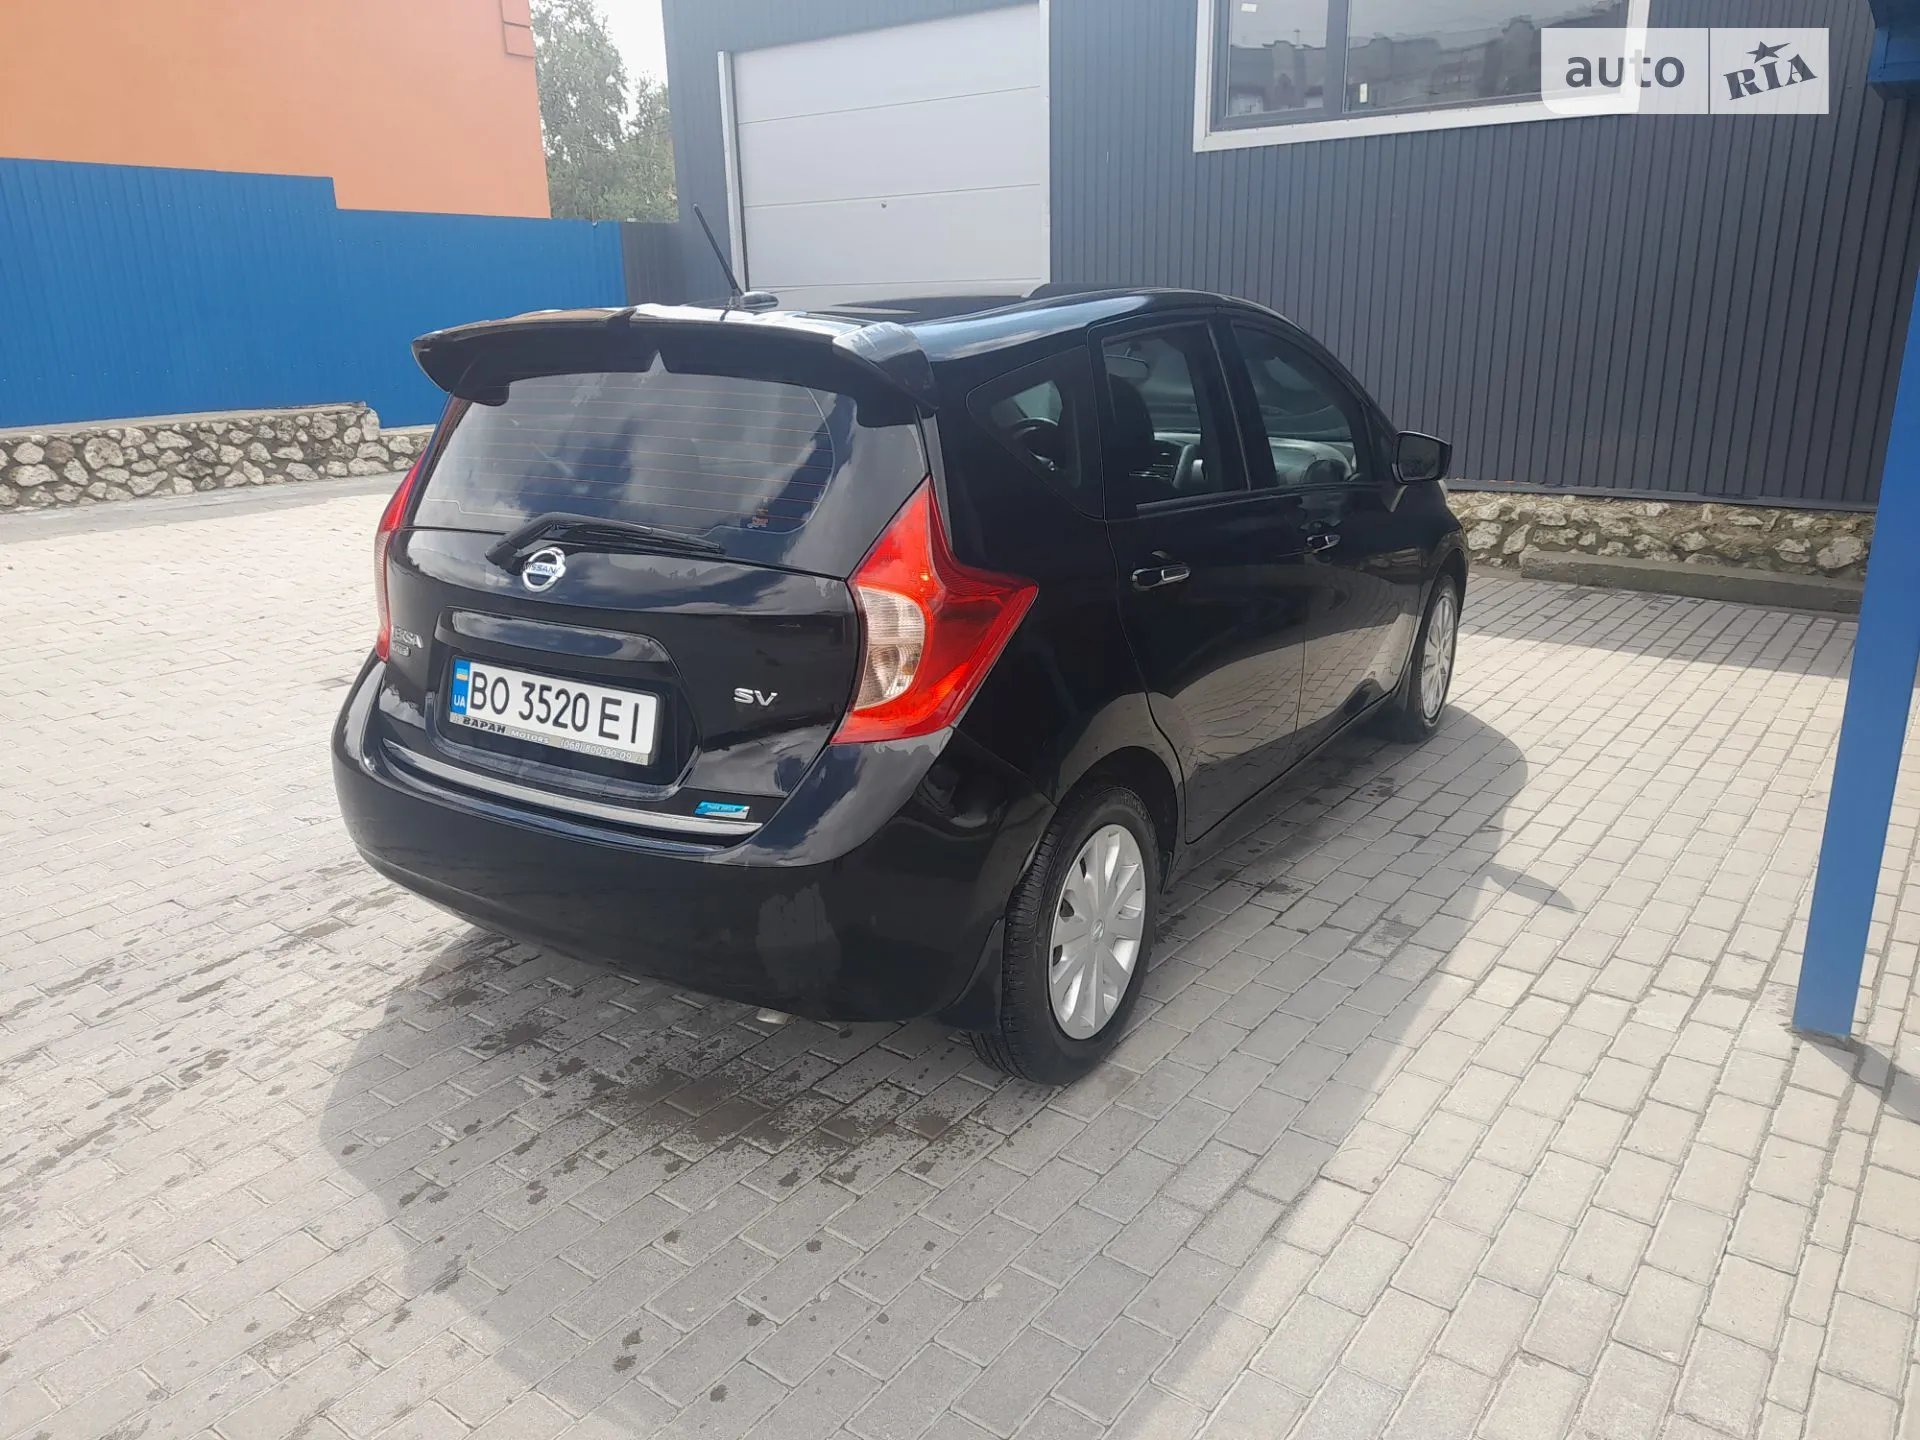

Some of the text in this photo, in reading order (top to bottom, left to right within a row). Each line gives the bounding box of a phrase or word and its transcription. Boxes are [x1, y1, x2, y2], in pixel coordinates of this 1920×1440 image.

[454, 694, 465, 708] UA
[733, 687, 778, 706] SV
[470, 672, 640, 744] BO 3520 EI
[511, 729, 550, 745] MOTORS
